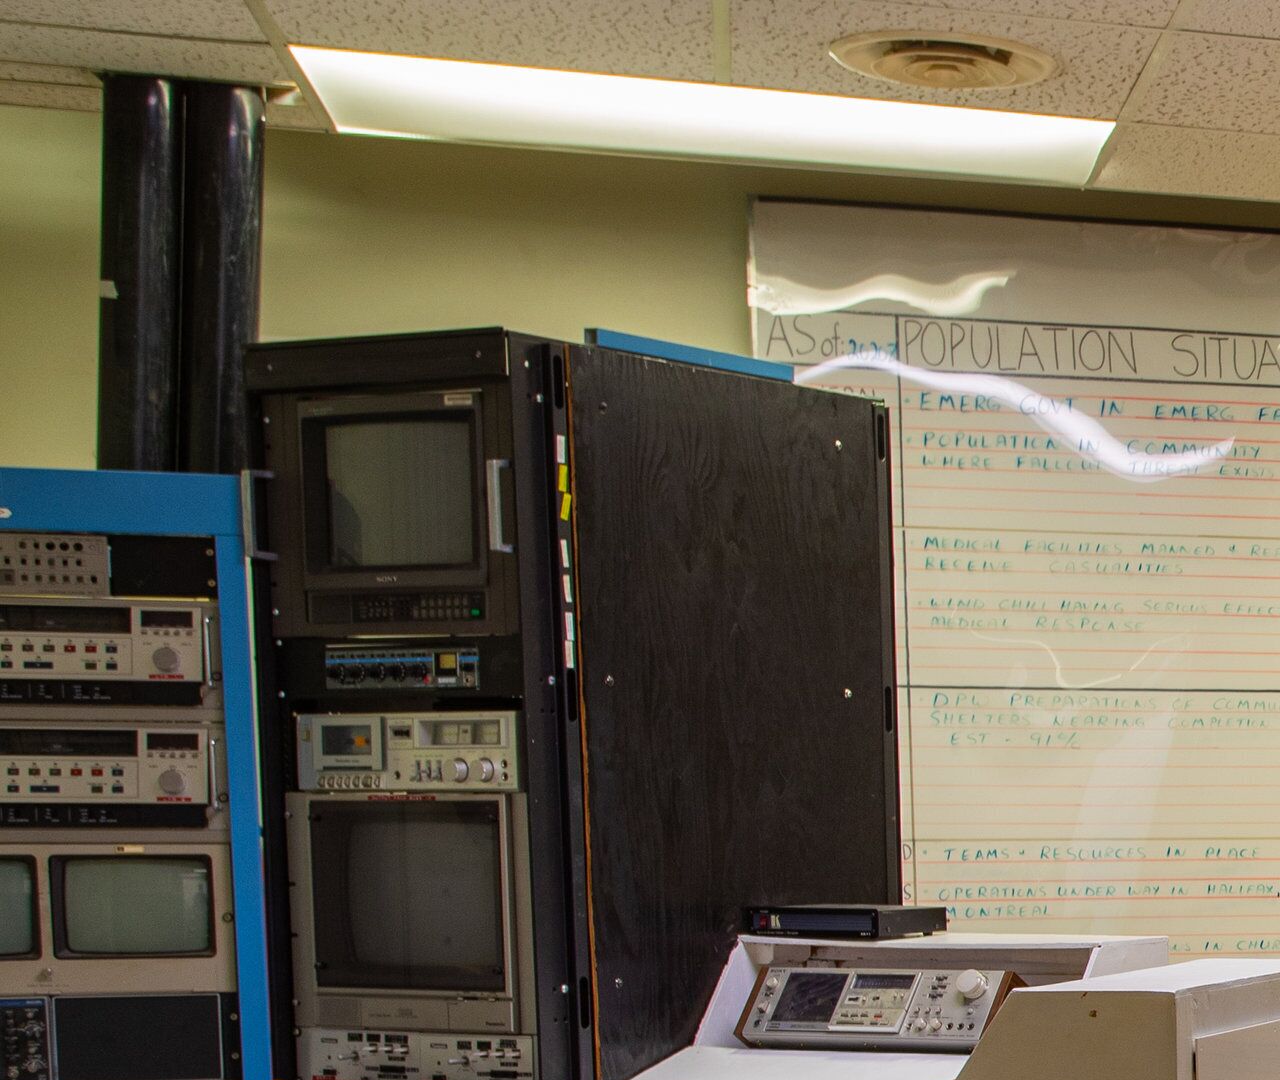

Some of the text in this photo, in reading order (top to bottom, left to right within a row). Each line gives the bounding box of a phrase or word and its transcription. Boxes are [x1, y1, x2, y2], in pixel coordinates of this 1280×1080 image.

[767, 314, 816, 358] AS
[904, 319, 1137, 373] POPULATION
[1154, 404, 1235, 421] EMERG
